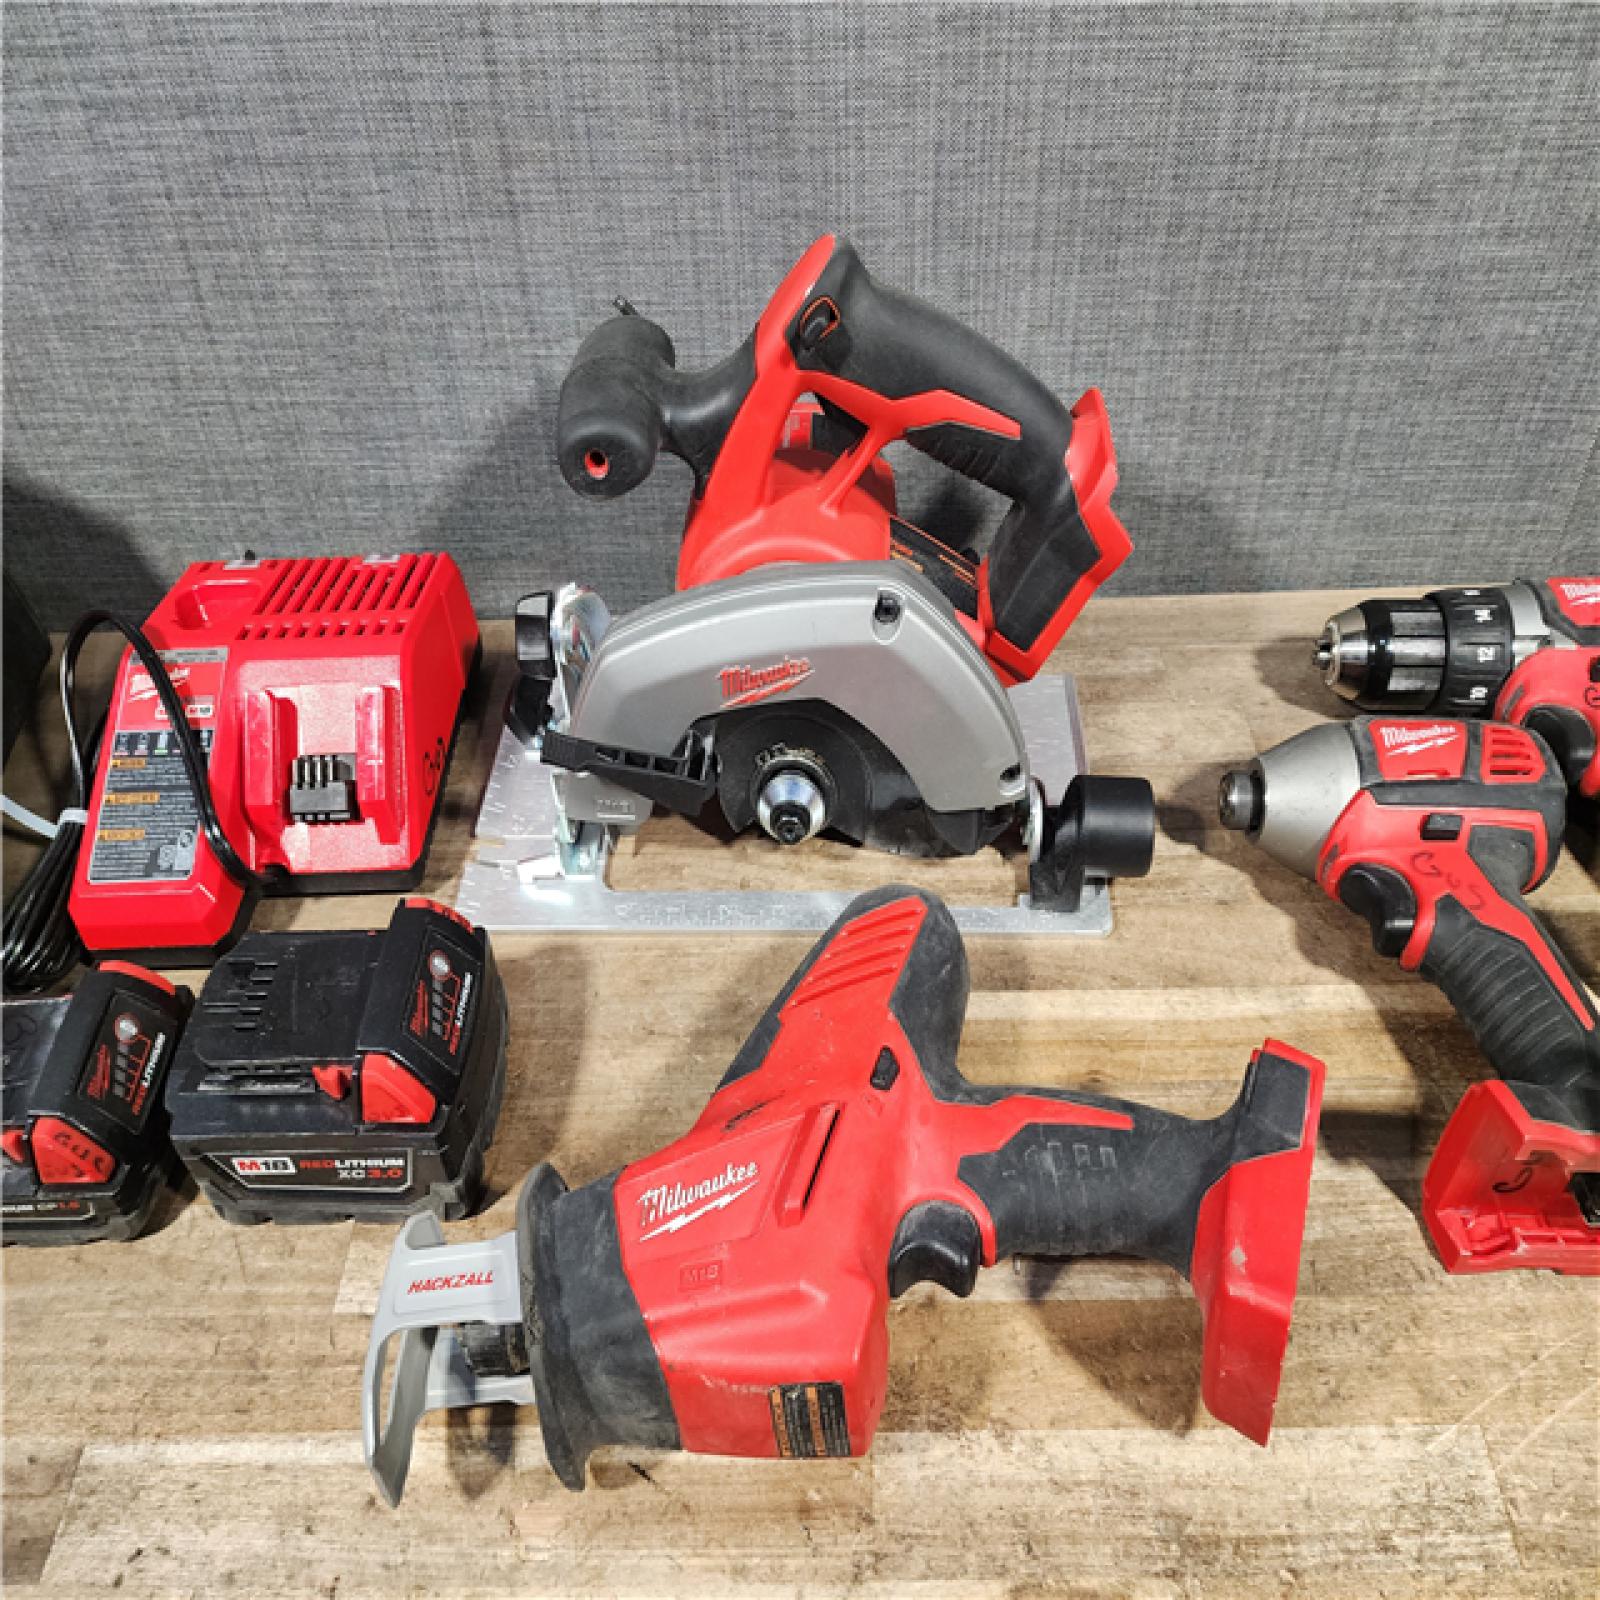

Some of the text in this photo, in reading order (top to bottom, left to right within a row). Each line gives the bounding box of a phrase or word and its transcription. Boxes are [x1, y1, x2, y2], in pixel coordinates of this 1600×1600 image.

[714, 654, 809, 699] Milwaukee
[1379, 724, 1457, 749] Milwaukee
[637, 1161, 758, 1227] Milwaukee
[406, 1269, 493, 1295] HACKZALL
